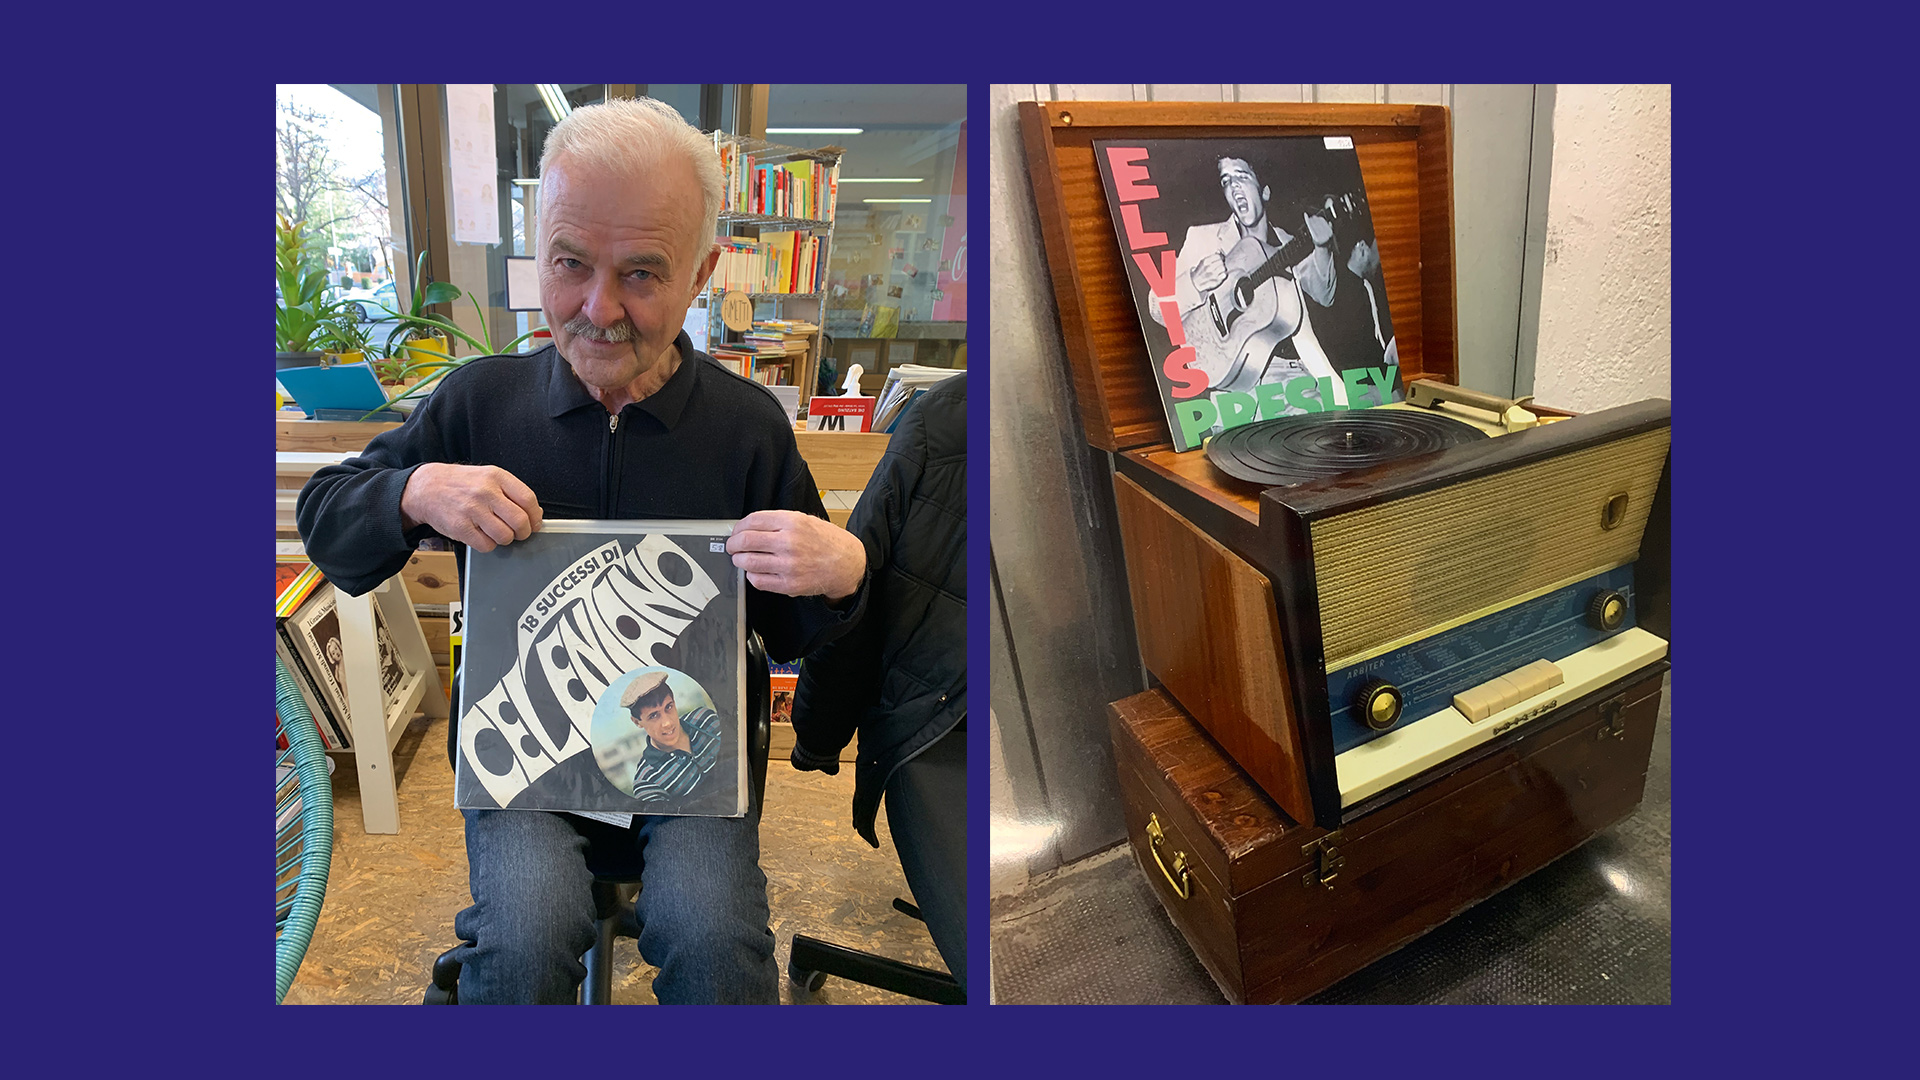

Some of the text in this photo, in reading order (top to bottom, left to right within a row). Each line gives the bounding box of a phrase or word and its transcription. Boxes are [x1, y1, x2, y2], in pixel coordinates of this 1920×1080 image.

[723, 299, 749, 323] FUMETTI
[1106, 147, 1210, 398] ELVIS
[1174, 365, 1400, 449] PRESLEY
[520, 545, 619, 634] 18 SUCCESSI DI
[460, 534, 721, 809] CELENTANO
[1347, 659, 1385, 680] ARBITER
